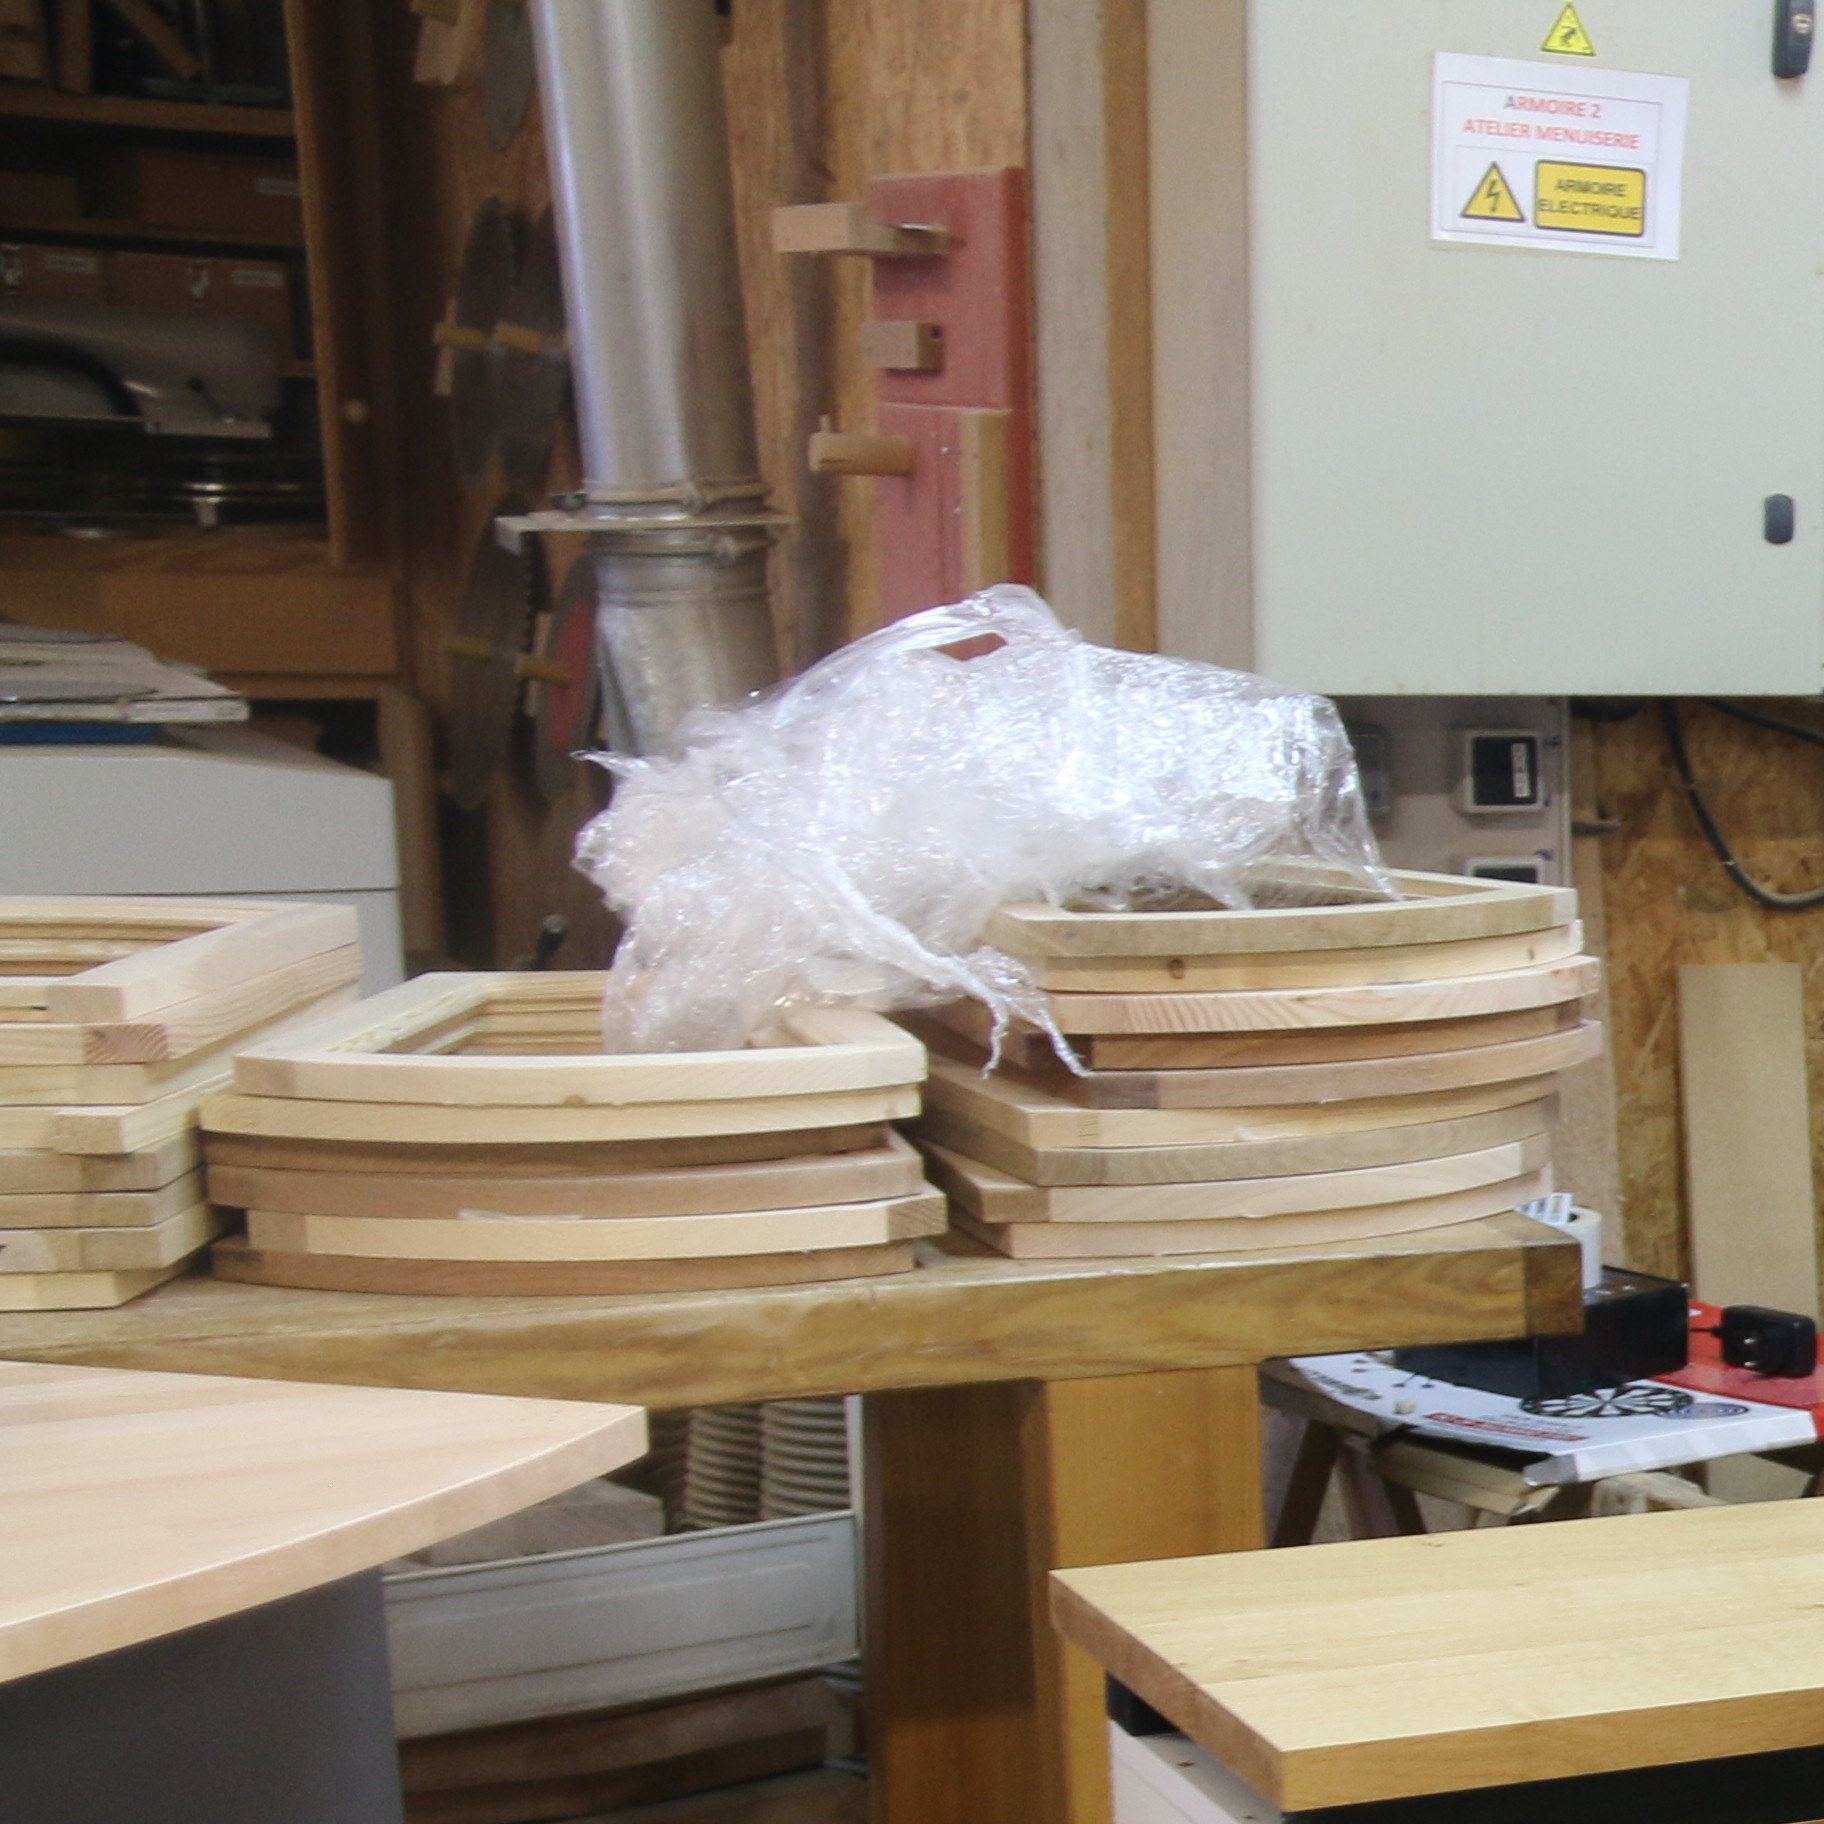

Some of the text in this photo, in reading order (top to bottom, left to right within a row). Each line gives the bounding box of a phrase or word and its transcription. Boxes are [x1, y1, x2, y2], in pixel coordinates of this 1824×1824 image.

[1505, 95, 1602, 119] ARMOIRE 2
[1463, 117, 1640, 149] ATELIER MENUISERIE
[1554, 178, 1627, 198] ARMOIRE
[1538, 198, 1641, 220] ELECTRIQUE
